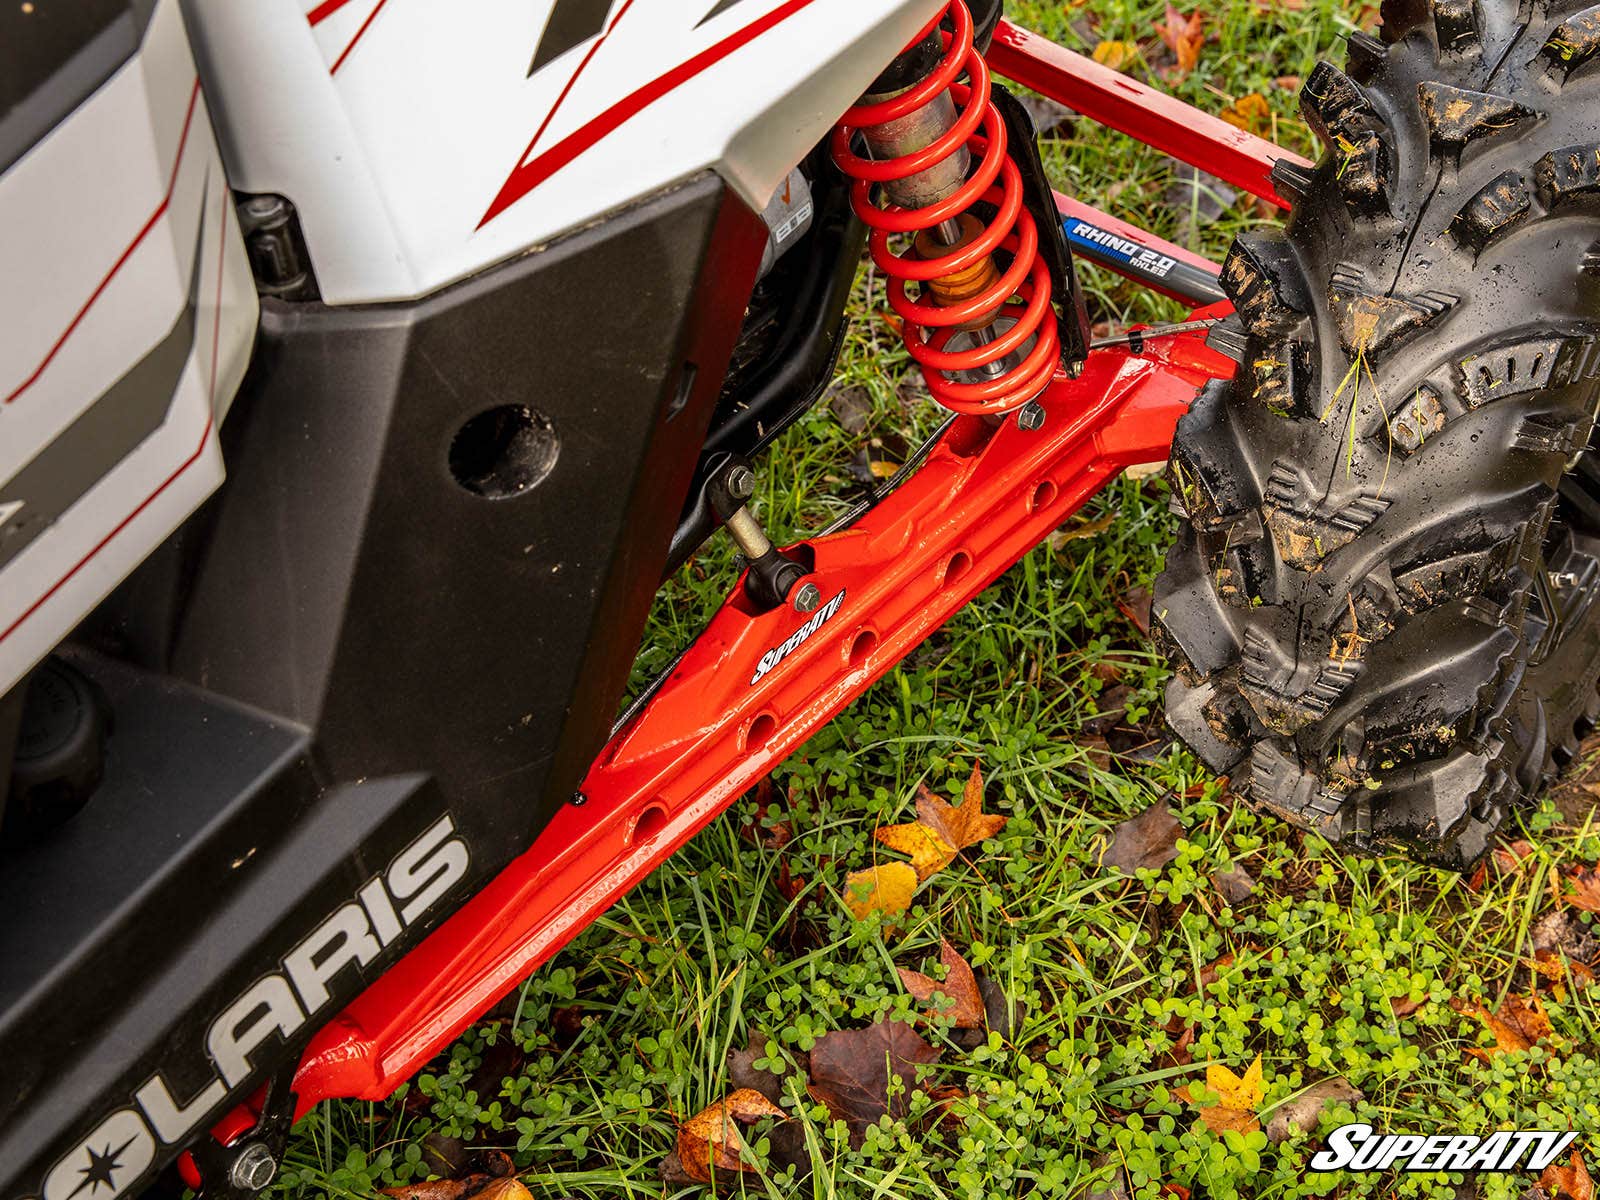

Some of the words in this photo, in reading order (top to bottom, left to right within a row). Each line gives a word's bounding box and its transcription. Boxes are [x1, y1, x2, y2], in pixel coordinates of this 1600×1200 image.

[1072, 222, 1136, 257] RHINO
[1137, 250, 1177, 272] 2.0
[1128, 256, 1169, 278] AXLES
[24, 815, 470, 1200] OLARIS
